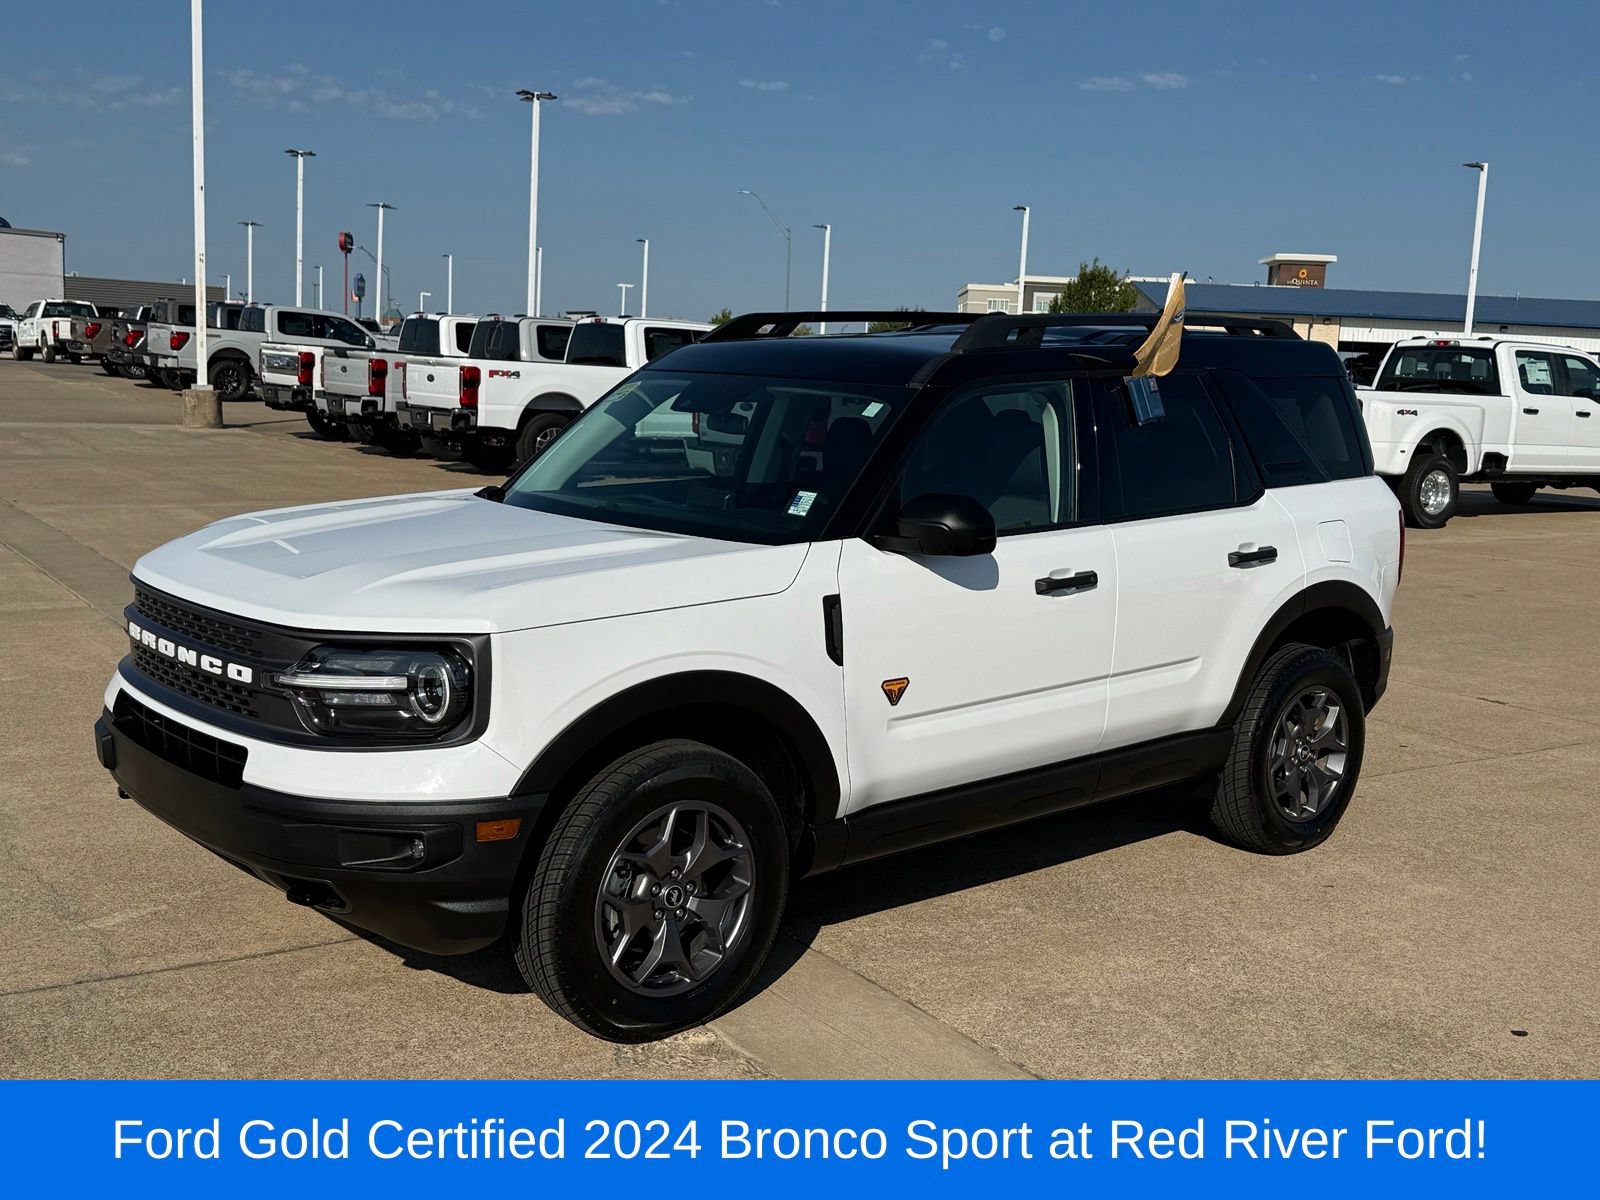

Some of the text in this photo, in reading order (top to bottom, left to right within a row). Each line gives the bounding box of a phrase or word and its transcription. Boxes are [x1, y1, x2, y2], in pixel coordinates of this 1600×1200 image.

[1291, 278, 1319, 286] QUINTA
[488, 369, 520, 379] FX4
[129, 621, 253, 684] BRONCO
